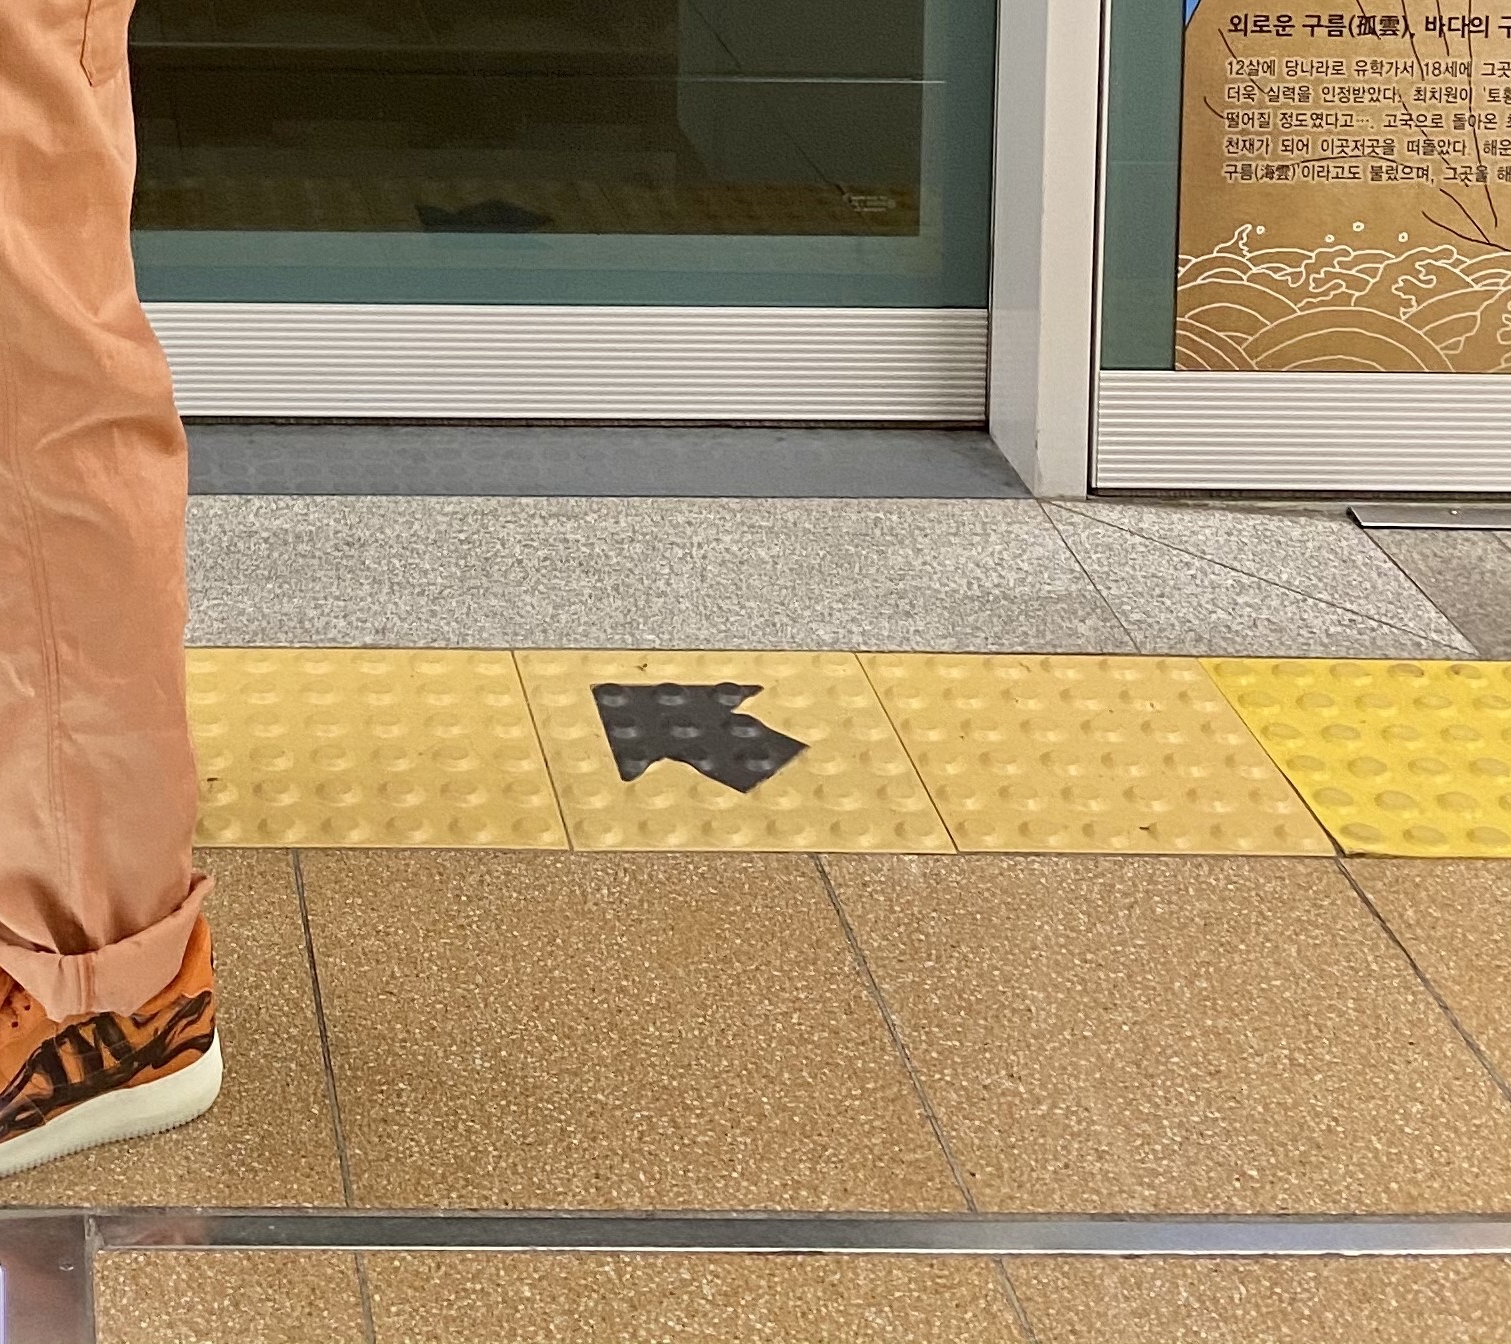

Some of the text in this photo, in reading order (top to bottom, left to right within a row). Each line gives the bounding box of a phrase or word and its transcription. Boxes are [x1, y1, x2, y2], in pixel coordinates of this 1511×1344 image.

[1228, 13, 1295, 37] 외로운
[1425, 15, 1489, 39] 바다의
[1227, 59, 1275, 77] 12살에
[1285, 60, 1345, 77] 당나라로
[1354, 60, 1414, 77] 유학가서
[1424, 61, 1472, 78] 18세에
[1227, 85, 1256, 102] 더욱
[1266, 85, 1312, 103] 실력을
[1413, 86, 1472, 103] 최치원이
[1225, 112, 1271, 129] 떨어질
[1383, 113, 1444, 130] 고국으로
[1453, 113, 1497, 130] 돌아온
[1225, 137, 1269, 155] 천재가
[1281, 138, 1309, 155] 되어
[1321, 138, 1396, 156] 이곳저곳을
[1370, 164, 1434, 184] 불렀으며,
[1444, 166, 1488, 183] 그곳을
